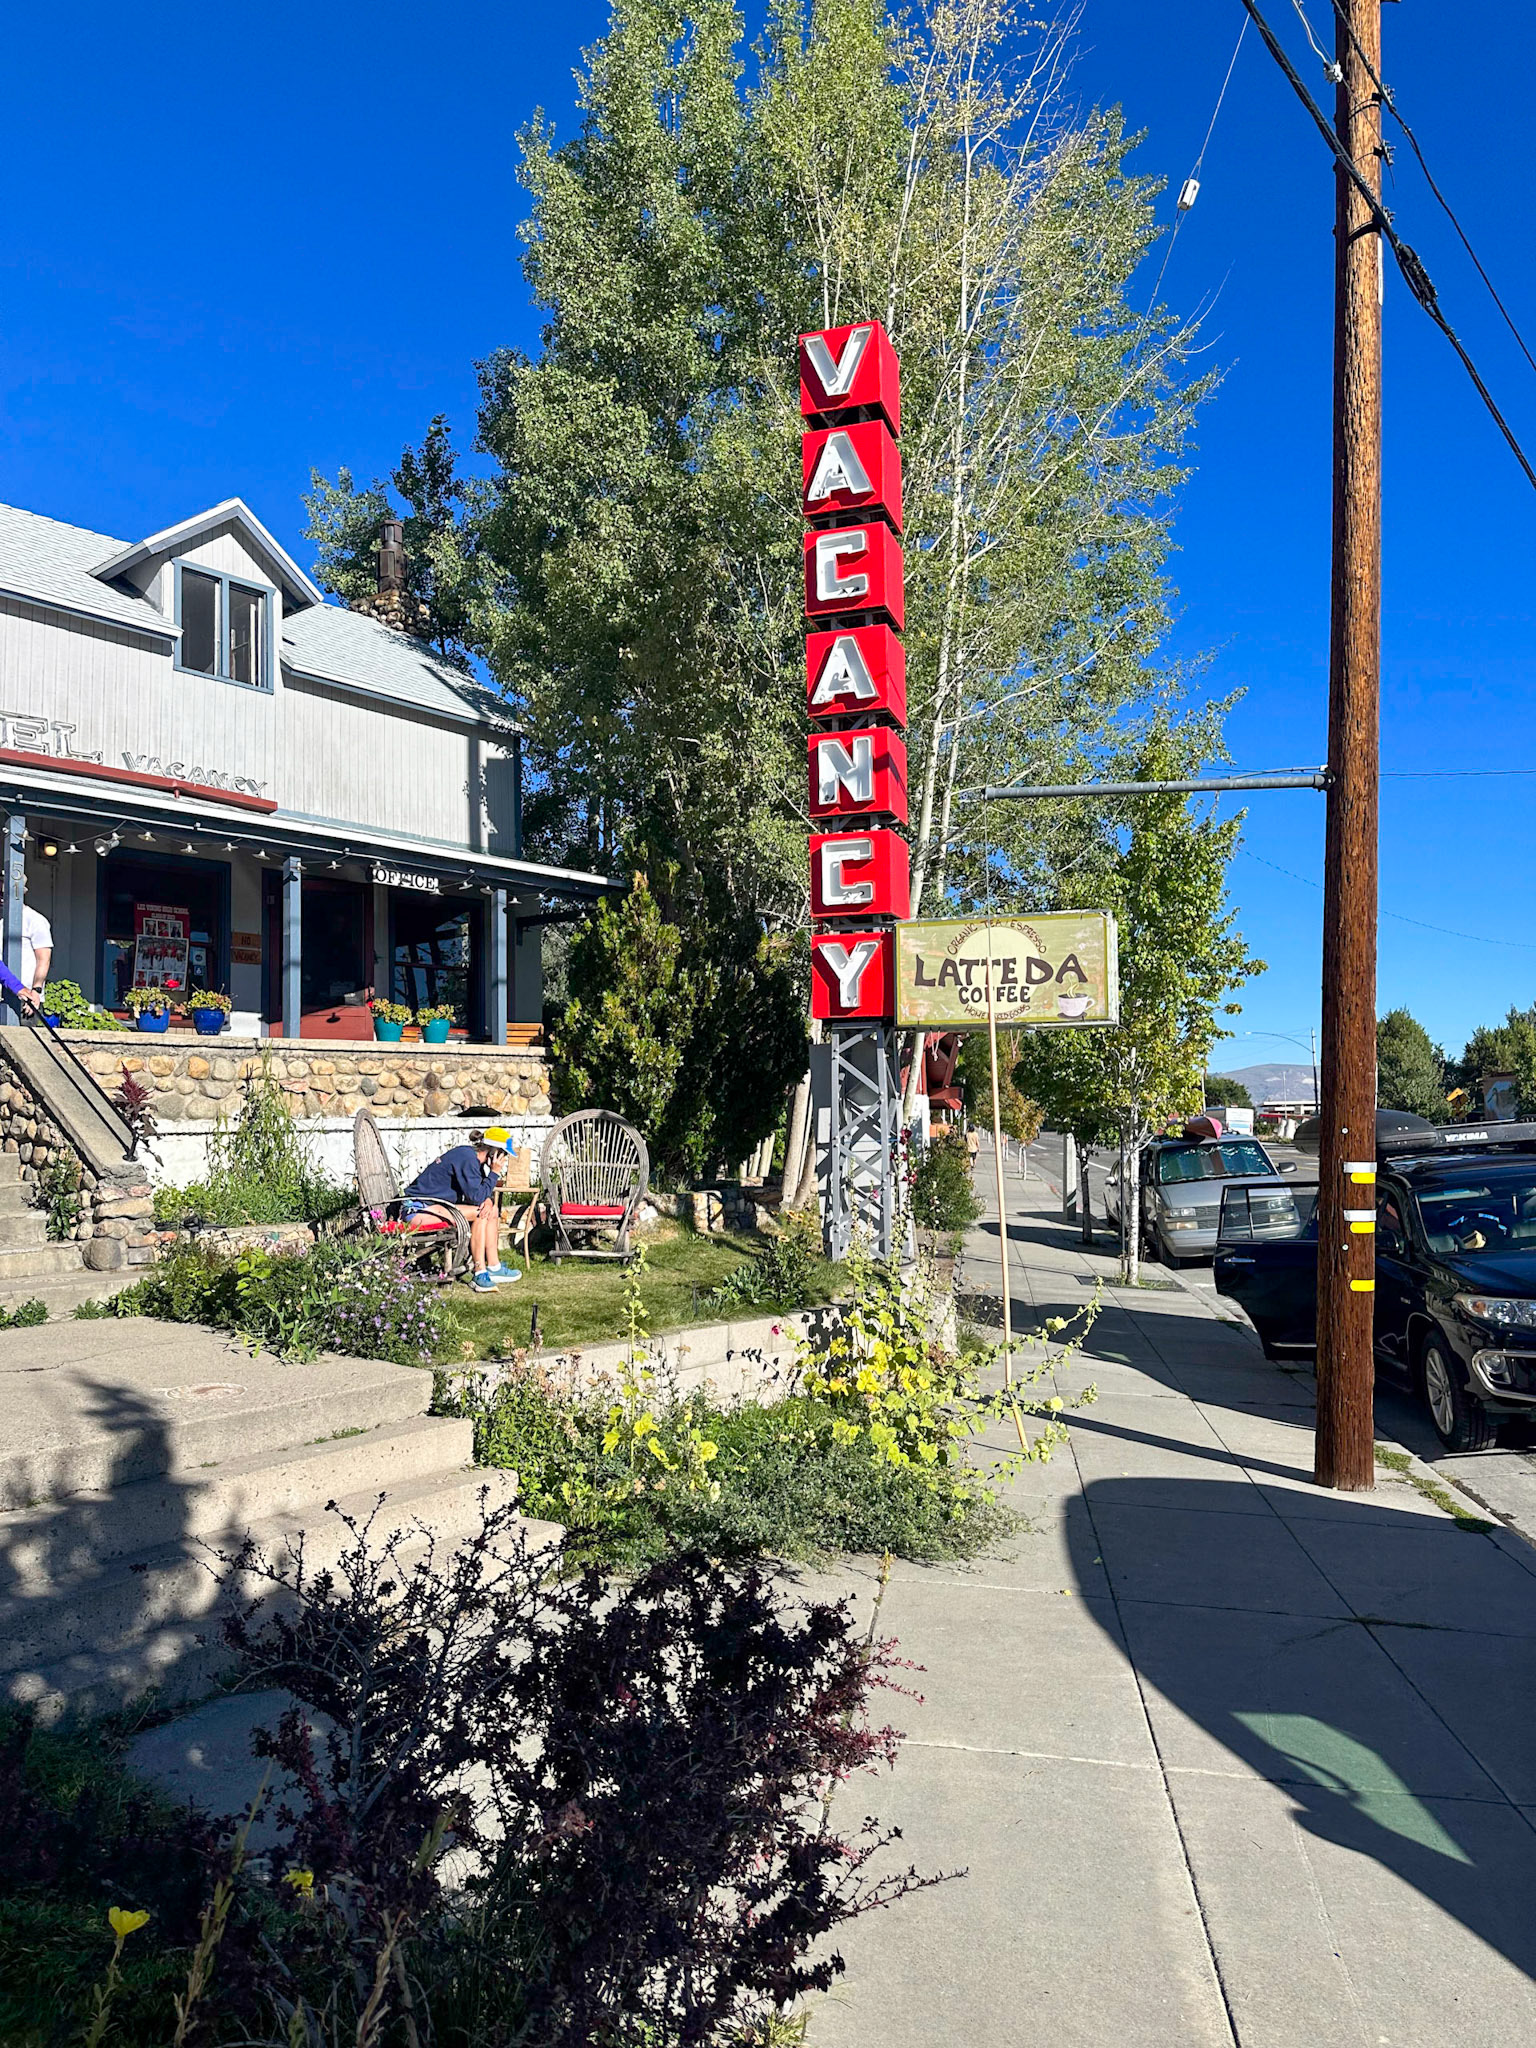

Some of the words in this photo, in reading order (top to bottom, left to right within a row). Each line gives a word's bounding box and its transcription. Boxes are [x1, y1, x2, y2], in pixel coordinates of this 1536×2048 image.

[802, 325, 881, 1008] VACANCY
[121, 752, 267, 798] VACANCY
[947, 923, 977, 955] ORGANIC
[1010, 919, 1047, 954] ESPRESSO
[914, 954, 1018, 987] LATTE
[1026, 953, 1088, 985] DA
[1445, 1132, 1488, 1142] YAKIMA
